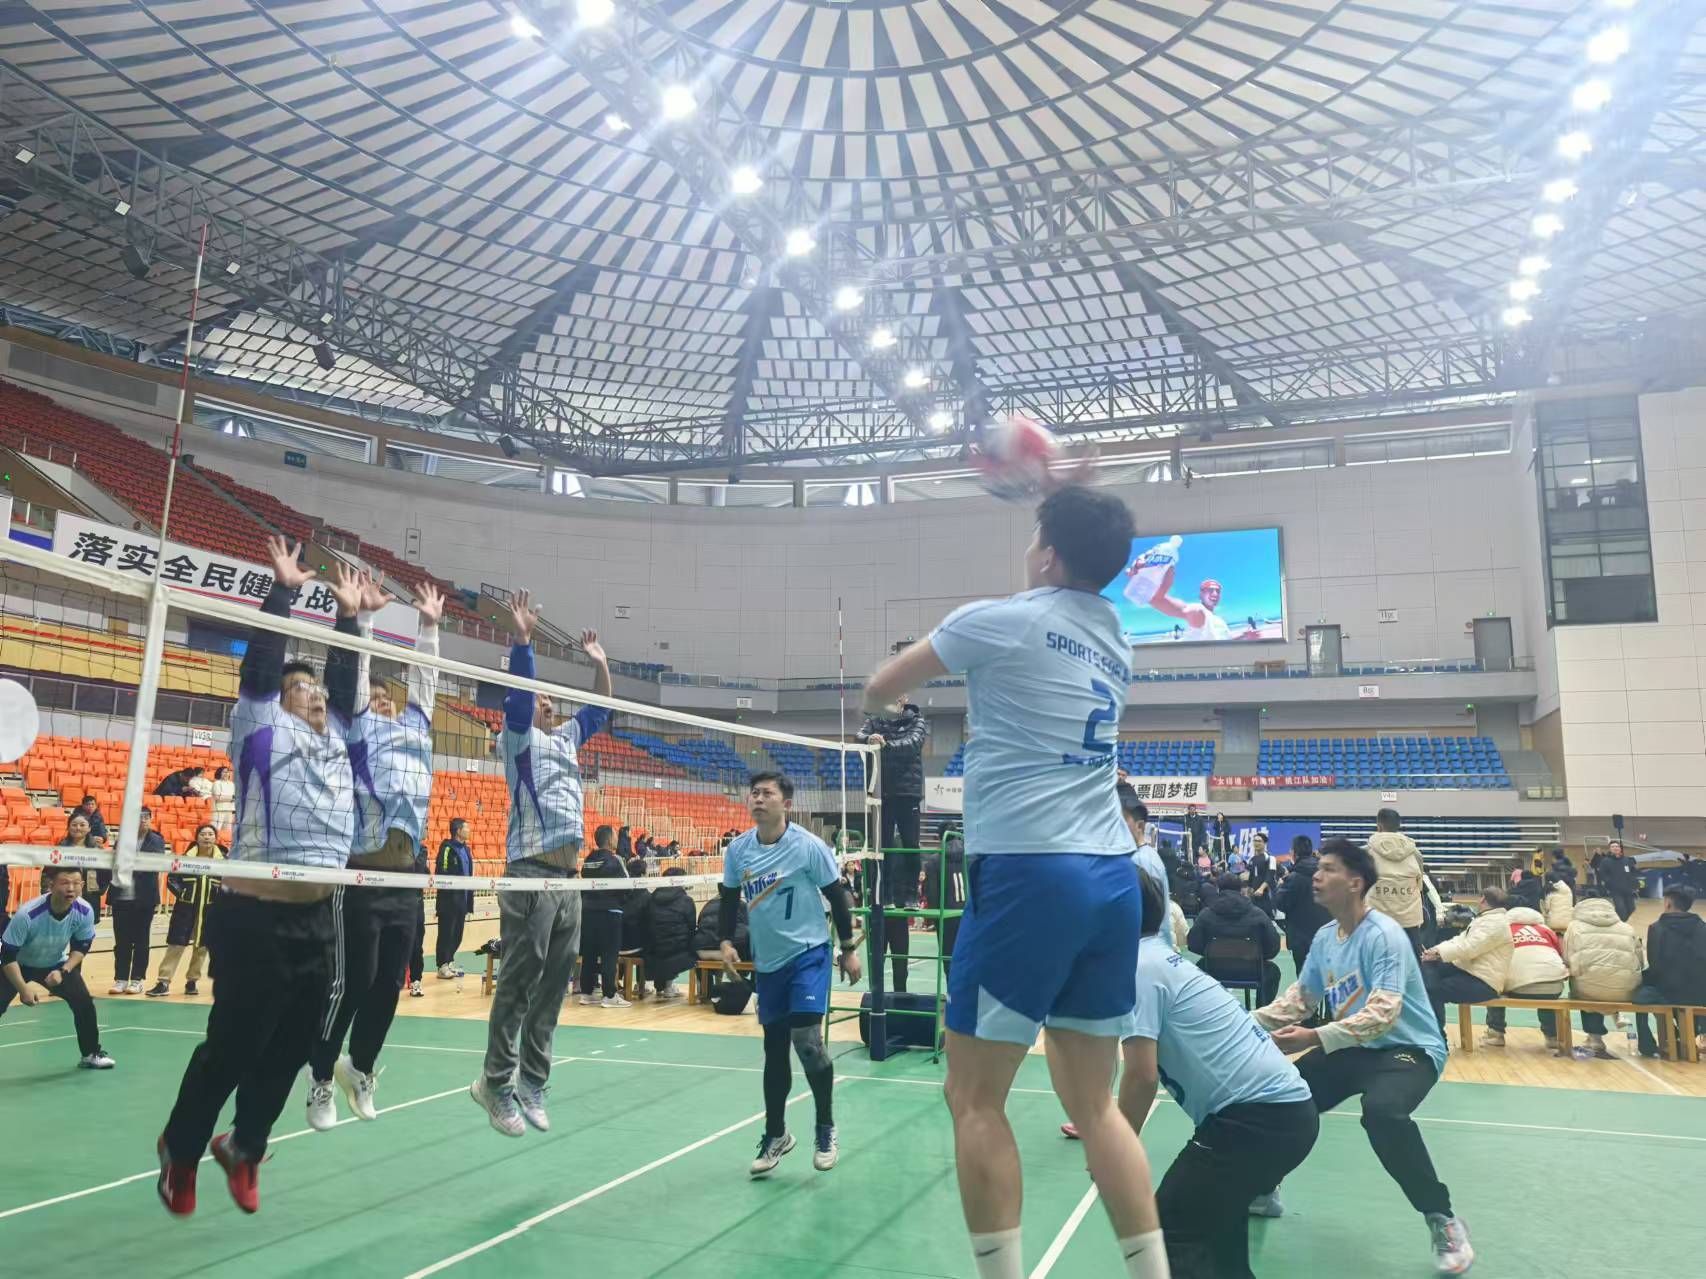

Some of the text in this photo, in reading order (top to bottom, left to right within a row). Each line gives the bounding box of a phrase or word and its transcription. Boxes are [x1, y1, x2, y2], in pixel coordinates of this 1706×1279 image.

[1082, 678, 1117, 752] 2
[1132, 782, 1198, 799] 票圆梦想
[776, 886, 795, 921] 7
[1375, 886, 1413, 896] SPACE
